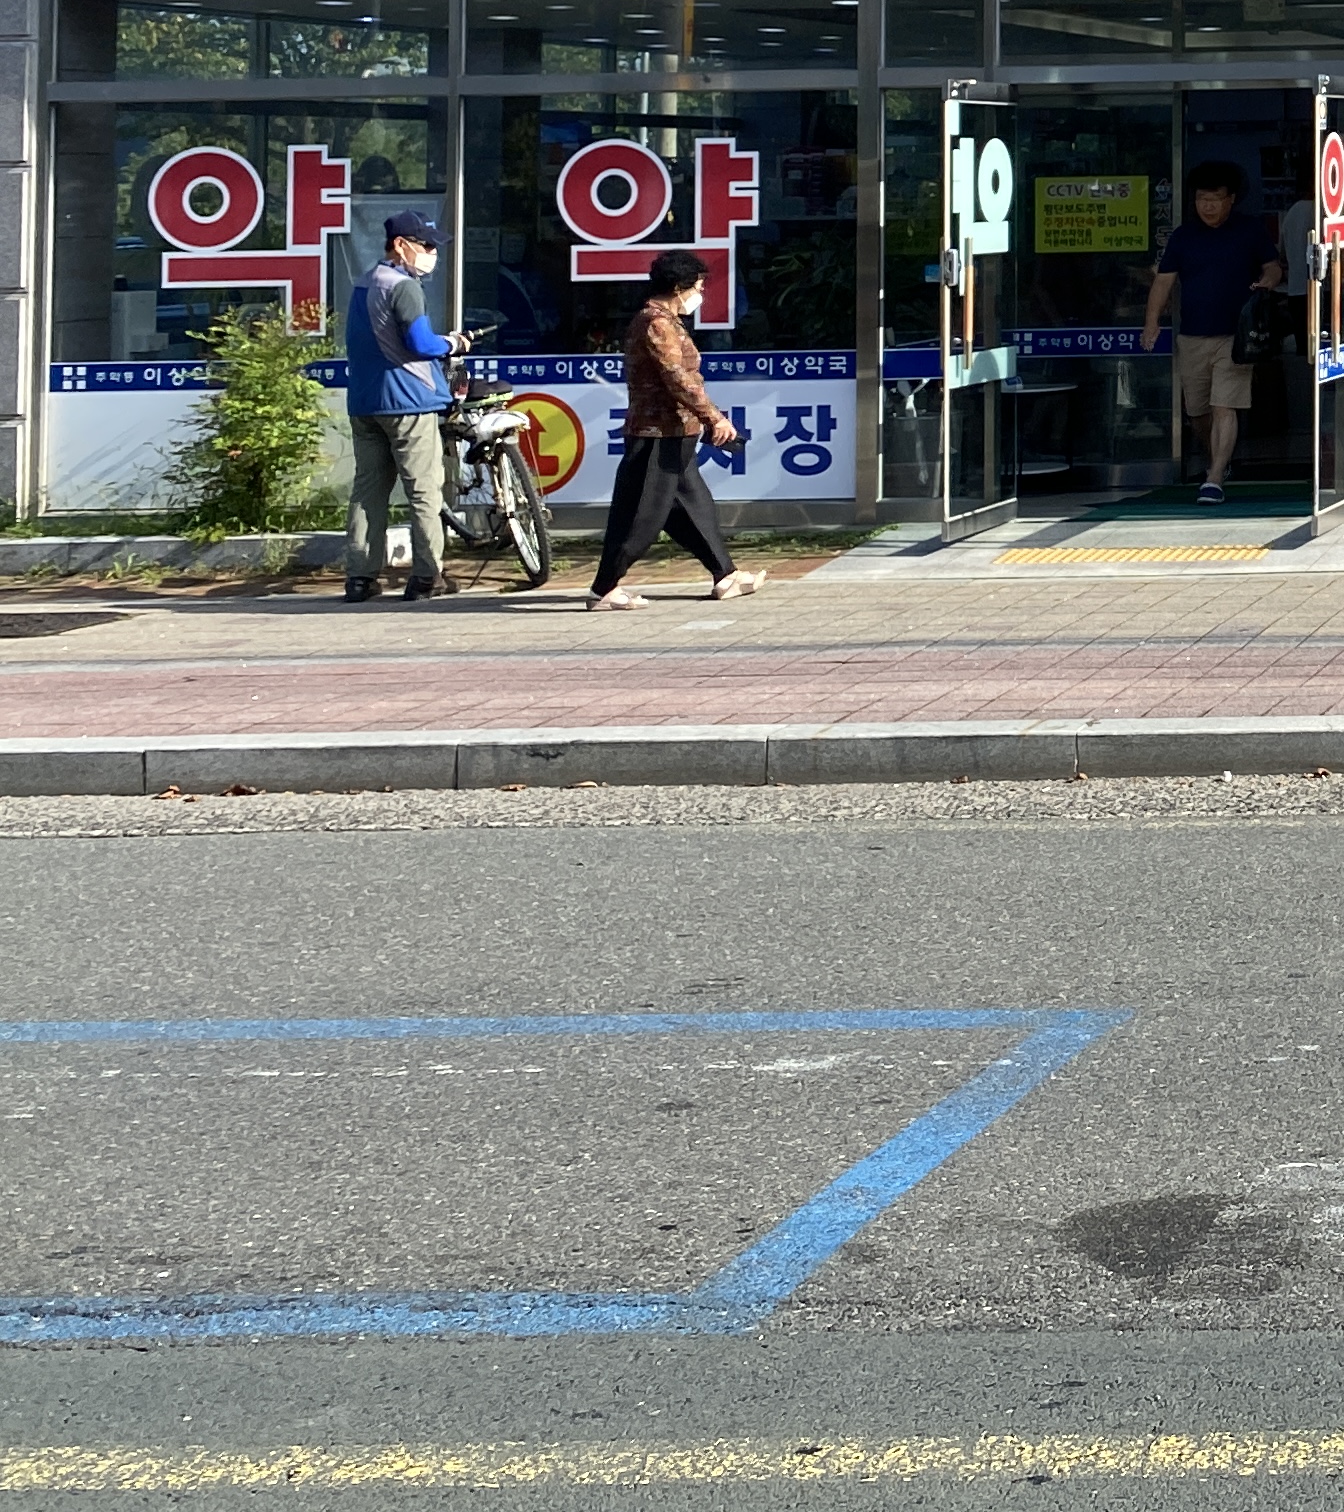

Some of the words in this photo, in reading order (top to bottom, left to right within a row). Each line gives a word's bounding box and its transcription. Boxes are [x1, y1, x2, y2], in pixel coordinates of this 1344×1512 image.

[1047, 183, 1084, 197] CCTV
[148, 144, 351, 336] 약
[556, 137, 759, 329] 약
[1077, 334, 1135, 350] 이상약
[143, 366, 213, 386] 이상약
[555, 360, 623, 379] 이상약
[755, 356, 847, 376] 이상약국
